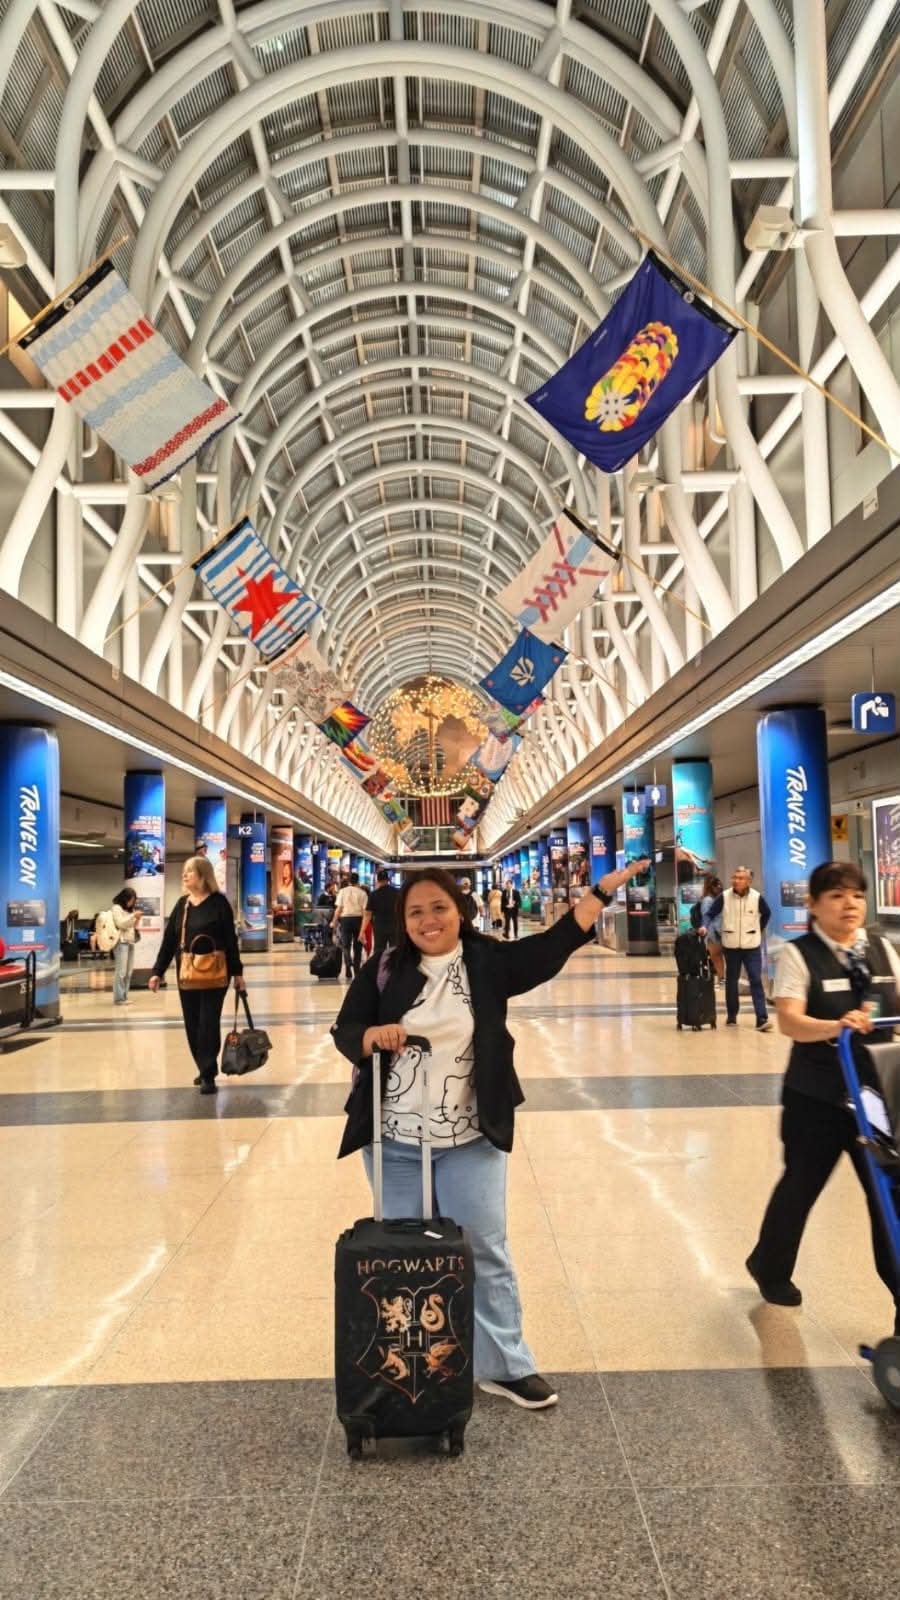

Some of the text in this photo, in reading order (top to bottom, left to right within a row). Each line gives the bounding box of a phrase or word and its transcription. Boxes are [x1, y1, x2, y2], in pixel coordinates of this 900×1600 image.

[785, 766, 808, 835] TRAVEL
[19, 784, 41, 854] TRAVEL
[238, 825, 252, 835] K2
[788, 837, 808, 867] ON
[19, 856, 38, 887] ON
